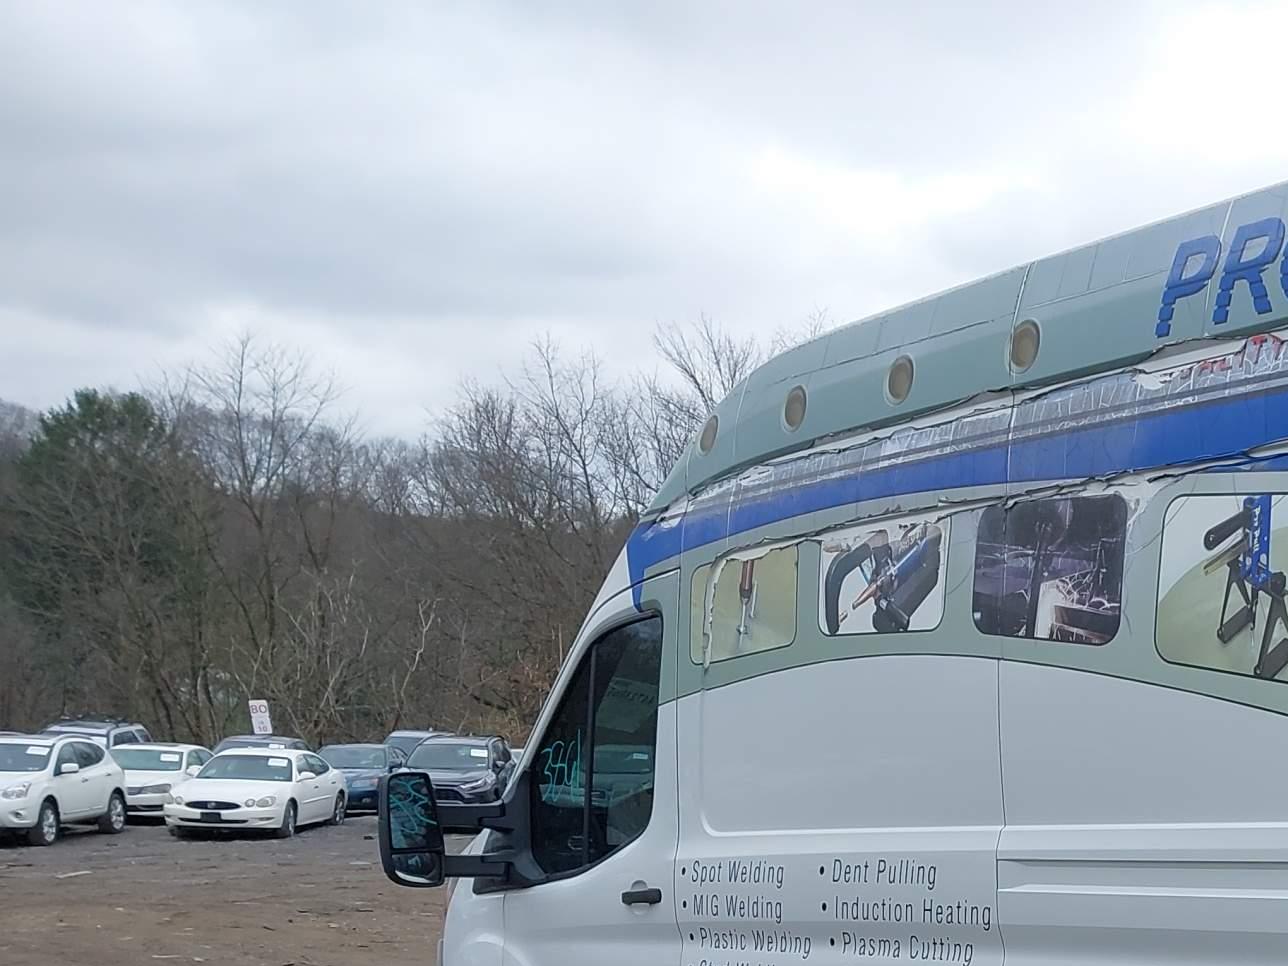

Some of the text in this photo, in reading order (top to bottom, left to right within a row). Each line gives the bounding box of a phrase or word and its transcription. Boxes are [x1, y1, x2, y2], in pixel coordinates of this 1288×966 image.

[691, 860, 784, 888] Spot Welding
[832, 859, 937, 890] Dent Pulling
[693, 894, 783, 924] MIG Welding
[835, 896, 991, 931] Induction Heating
[699, 928, 811, 959] Plastic Welding
[842, 932, 901, 959] Plasma
